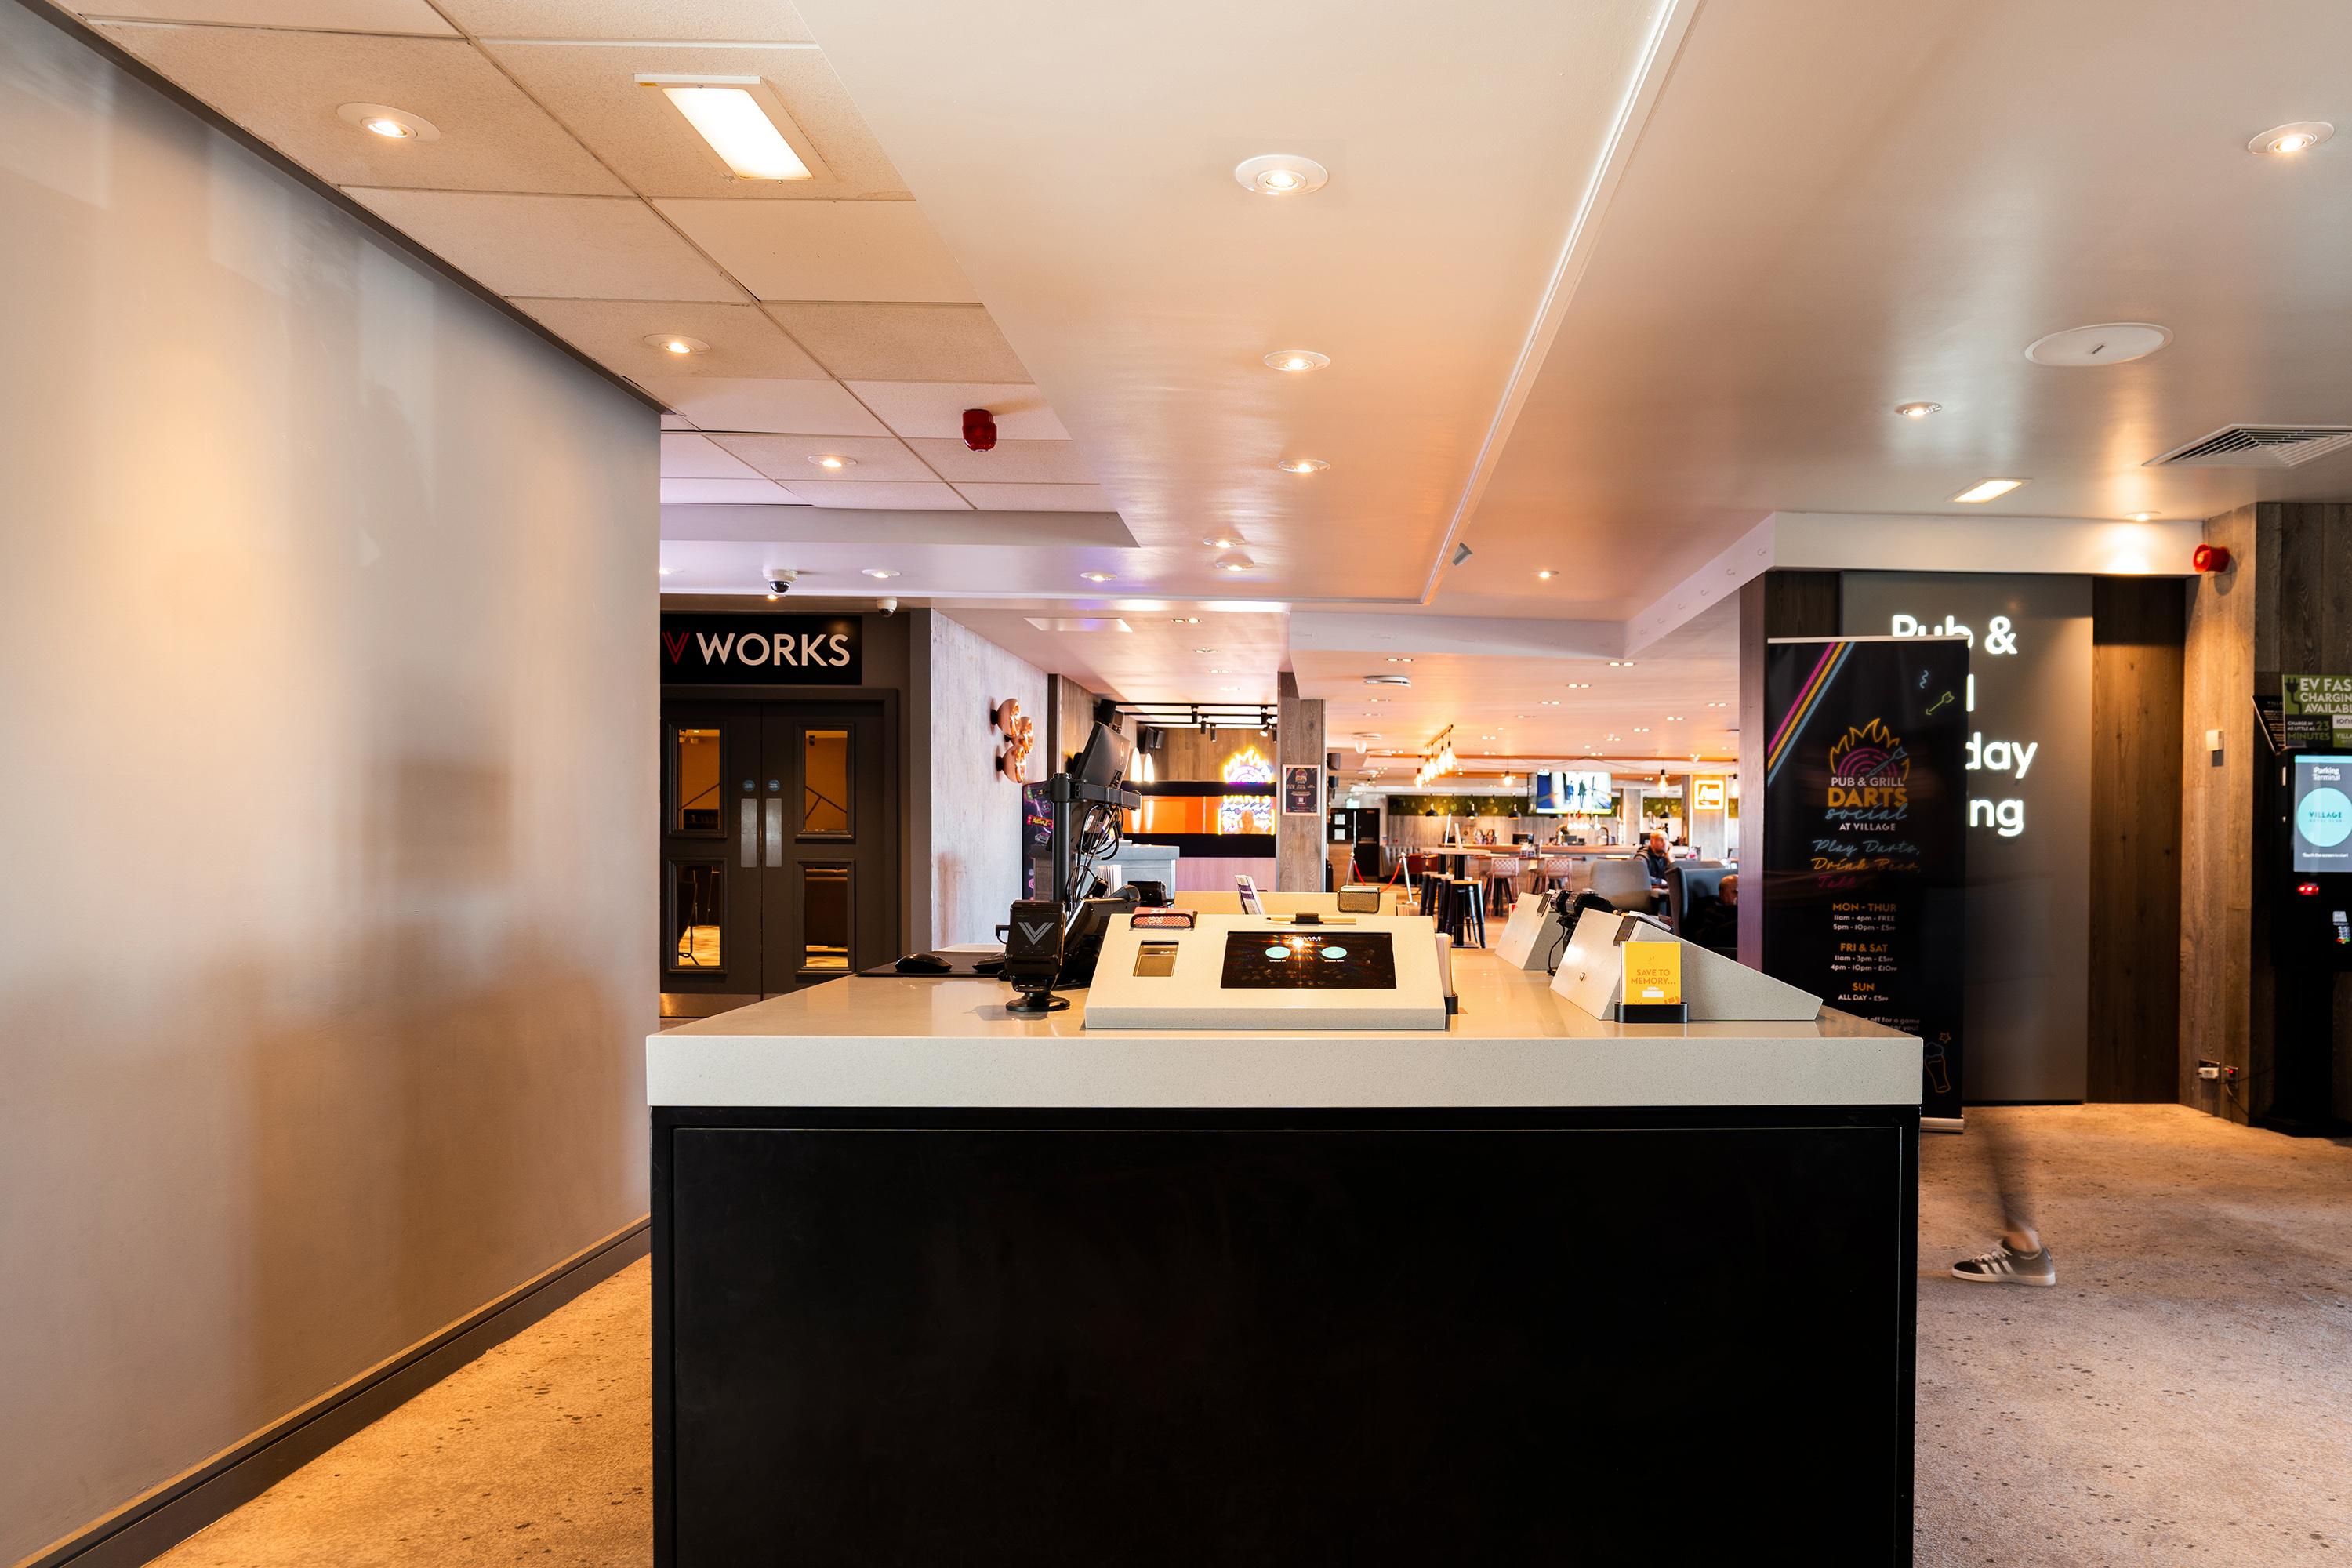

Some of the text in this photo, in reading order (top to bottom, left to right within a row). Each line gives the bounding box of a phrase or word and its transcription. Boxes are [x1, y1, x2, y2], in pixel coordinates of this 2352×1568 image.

[1984, 615, 2018, 655] &
[695, 633, 851, 666] WORKS
[2299, 677, 2321, 691] EV
[2315, 721, 2330, 731] 23
[2287, 732, 2330, 741] MINUTES
[1831, 777, 1905, 787] PUB & GRILL
[1827, 786, 1907, 808] DARTS
[1824, 802, 1909, 820] social
[1812, 840, 1920, 857] Play Darts,
[1810, 857, 1870, 871] Drink
[1832, 902, 1859, 911] MON
[1867, 902, 1897, 912] THUR
[1840, 943, 1889, 953] FRI & SAT
[1636, 968, 1671, 977] SAVE TO
[1631, 977, 1677, 985] MEMORY...
[1852, 982, 1875, 992] SUN
